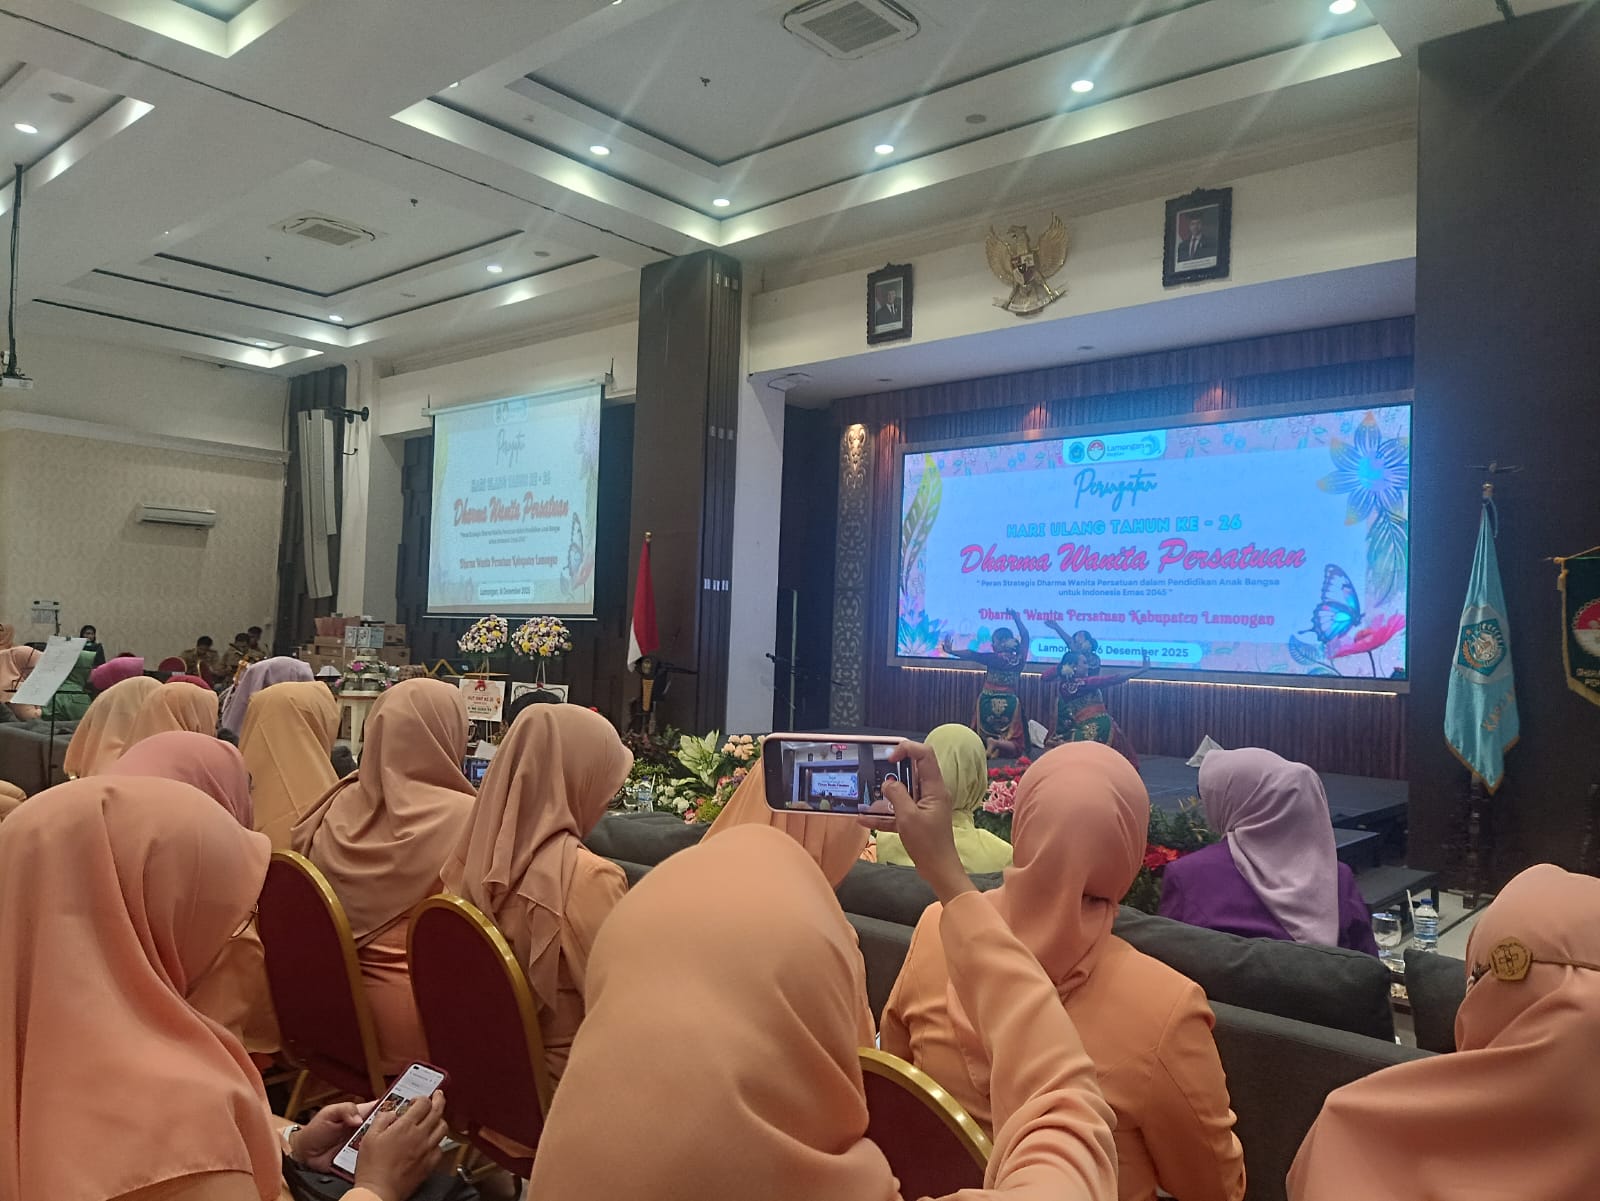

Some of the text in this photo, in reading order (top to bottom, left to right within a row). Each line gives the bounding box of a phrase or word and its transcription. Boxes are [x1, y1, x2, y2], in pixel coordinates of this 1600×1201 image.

[1007, 523, 1046, 538] HARI
[1050, 520, 1106, 536] ULANG
[1110, 517, 1170, 535] TAHUN
[1175, 516, 1199, 532] KE
[1218, 514, 1242, 531] 26
[960, 537, 1307, 574] Dharma Wanita Persatuan
[1003, 579, 1035, 588] Strategis
[1037, 579, 1066, 587] Dharma
[1097, 578, 1138, 586] Persatuan
[1140, 578, 1166, 586] dalam
[1167, 578, 1218, 586] Pendidikan
[1219, 577, 1242, 586] Anak
[1244, 578, 1280, 587] Bangsa
[1058, 588, 1081, 596] untuk
[1082, 588, 1121, 596] Indonesia
[1122, 588, 1144, 596] Emas
[1023, 608, 1064, 621] Wanita
[1066, 609, 1126, 623] Persatuan
[1129, 609, 1198, 626] Kabupaten
[1201, 611, 1275, 628] Lamongan
[1161, 647, 1189, 657] 2025
